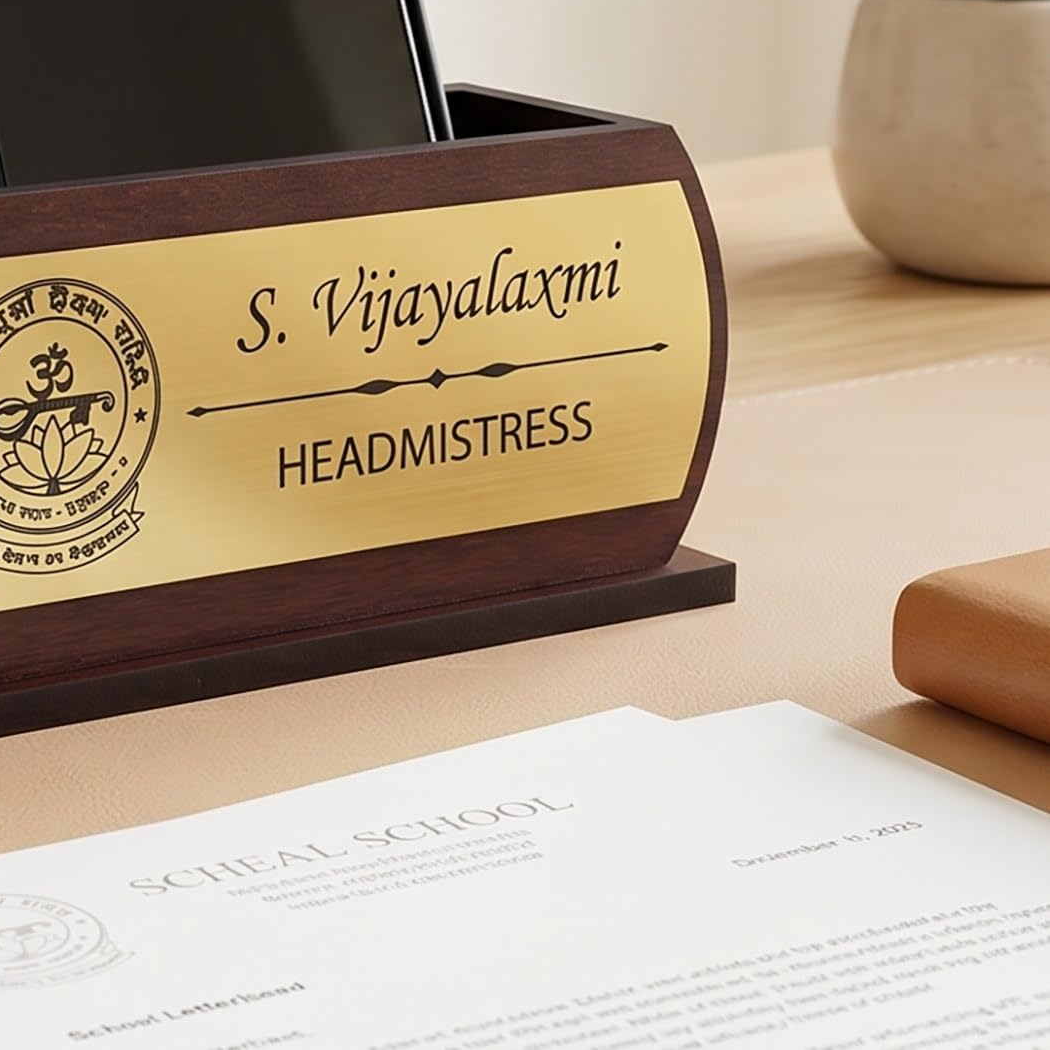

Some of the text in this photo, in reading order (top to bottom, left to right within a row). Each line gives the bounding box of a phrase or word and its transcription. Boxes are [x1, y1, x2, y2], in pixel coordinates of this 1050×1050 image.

[237, 286, 287, 353] S.
[312, 240, 623, 354] Vijayalaxmi
[278, 401, 593, 488] HEADMISTRESS
[129, 842, 349, 897] SCHEAL
[352, 796, 575, 848] SCHOOL
